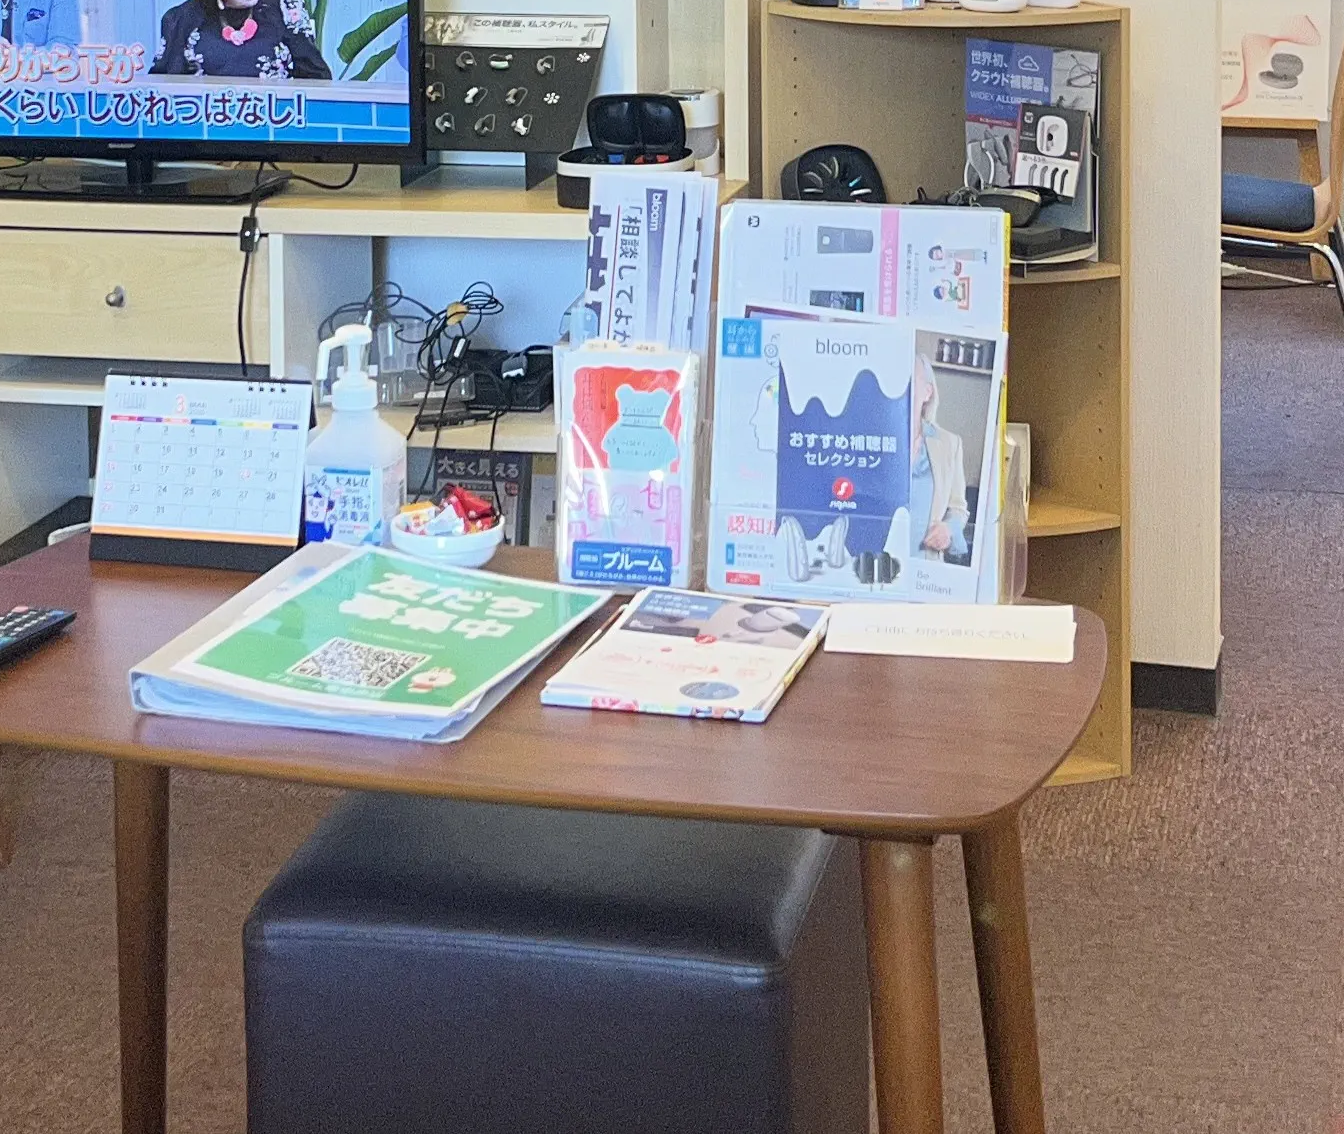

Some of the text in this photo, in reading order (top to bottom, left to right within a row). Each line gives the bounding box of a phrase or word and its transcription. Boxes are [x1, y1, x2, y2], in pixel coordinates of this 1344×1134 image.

[971, 50, 1008, 68] 世界初、
[971, 69, 1050, 93] クラウド補聴器。
[970, 91, 995, 101] WIDEX
[88, 88, 307, 127] しびれっぱなし!
[650, 192, 663, 232] bloom
[815, 337, 869, 357] bloom
[175, 394, 186, 414] 3
[789, 431, 898, 454] おすすめ補聴器
[438, 456, 519, 479] 大きく見える
[805, 452, 882, 469] セレクション
[602, 551, 666, 573] ブルーム
[367, 572, 545, 618] 友だち
